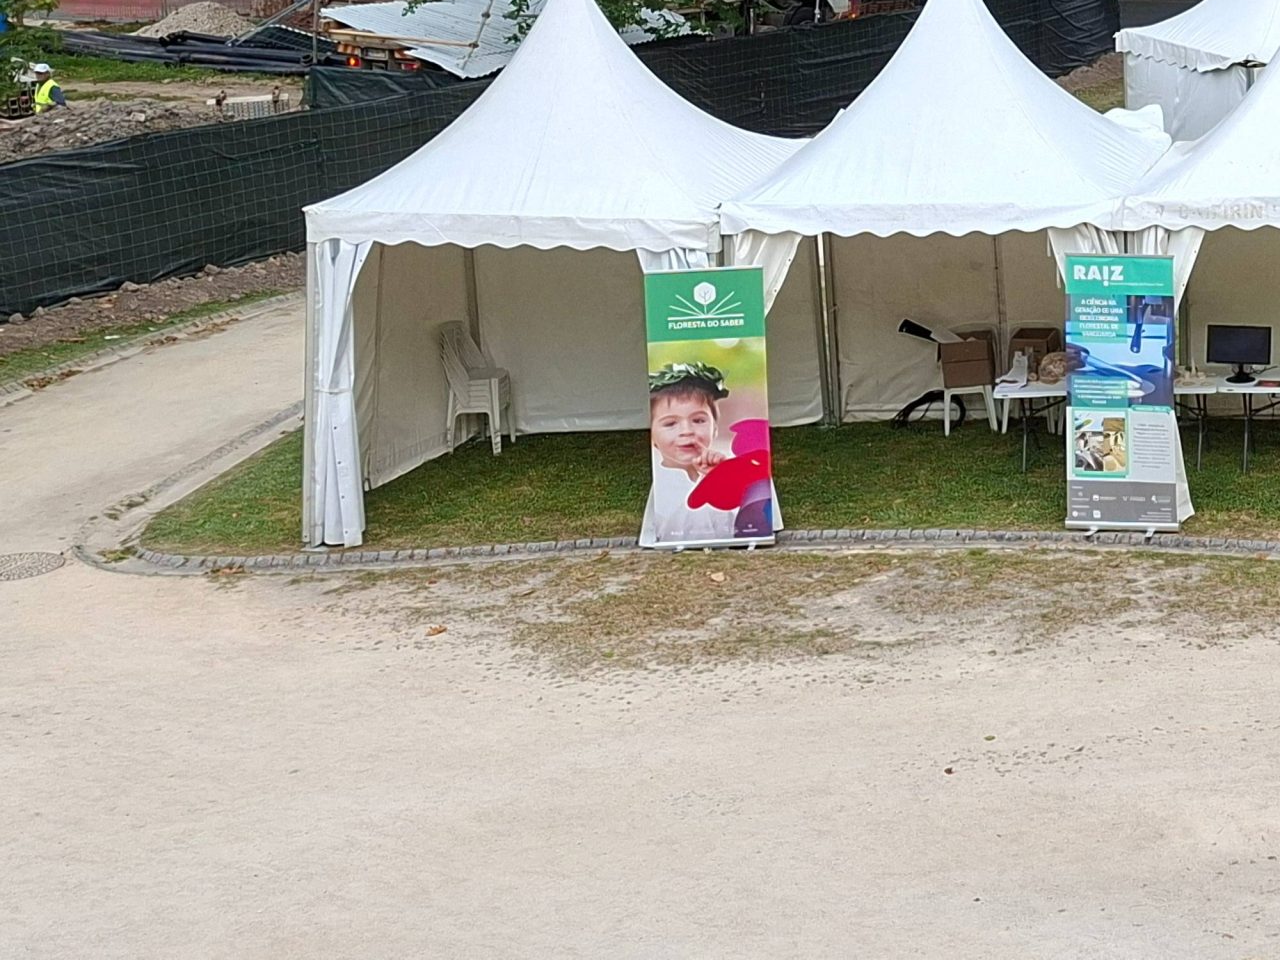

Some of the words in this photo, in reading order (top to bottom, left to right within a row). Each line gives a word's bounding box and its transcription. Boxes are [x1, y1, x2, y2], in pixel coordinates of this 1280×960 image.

[1073, 264, 1124, 286] RAIZ
[668, 320, 706, 330] FLORESTA
[707, 320, 719, 328] DO
[720, 319, 744, 327] SABER
